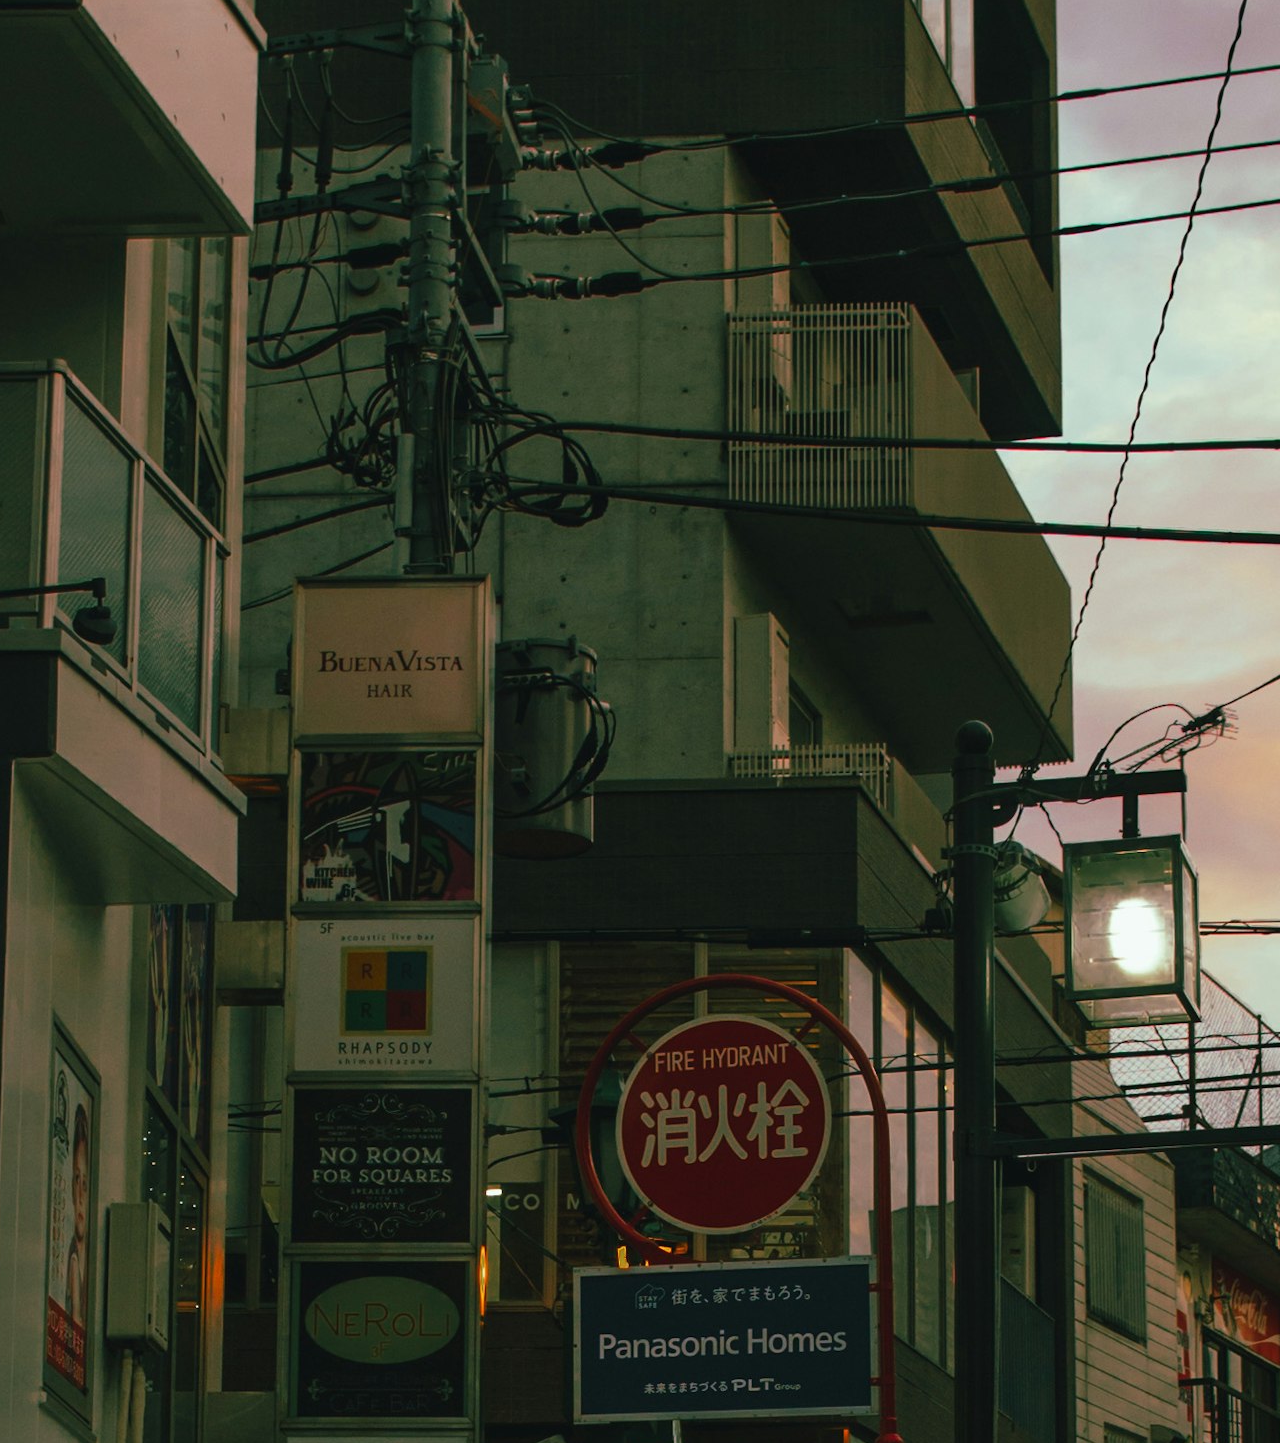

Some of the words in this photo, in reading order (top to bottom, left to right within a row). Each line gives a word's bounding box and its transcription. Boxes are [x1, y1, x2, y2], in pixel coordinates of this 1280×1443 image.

[367, 683, 412, 698] HAIR
[306, 877, 334, 889] WINE
[319, 922, 334, 934] 5F
[341, 933, 386, 942] acoustic
[391, 933, 412, 941] live
[417, 933, 435, 942] bar
[338, 1042, 433, 1055] RHAPSODY
[654, 1048, 695, 1073] FIRE
[701, 1042, 790, 1070] HYDRANT
[639, 1078, 811, 1169] 消火栓
[319, 1146, 357, 1164] NO
[366, 1146, 445, 1164] ROOM
[311, 1168, 351, 1183] FOR
[358, 1168, 452, 1185] SQUARES
[638, 1294, 658, 1303] STAY
[671, 1284, 812, 1306] 街を、家でまもろう。
[638, 1301, 658, 1309] SAFE
[599, 1328, 739, 1360] Panasonic
[747, 1327, 848, 1355] Homes
[643, 1380, 729, 1395] 未来をまちづくる
[731, 1377, 775, 1393] PLT
[774, 1380, 801, 1393] Group
